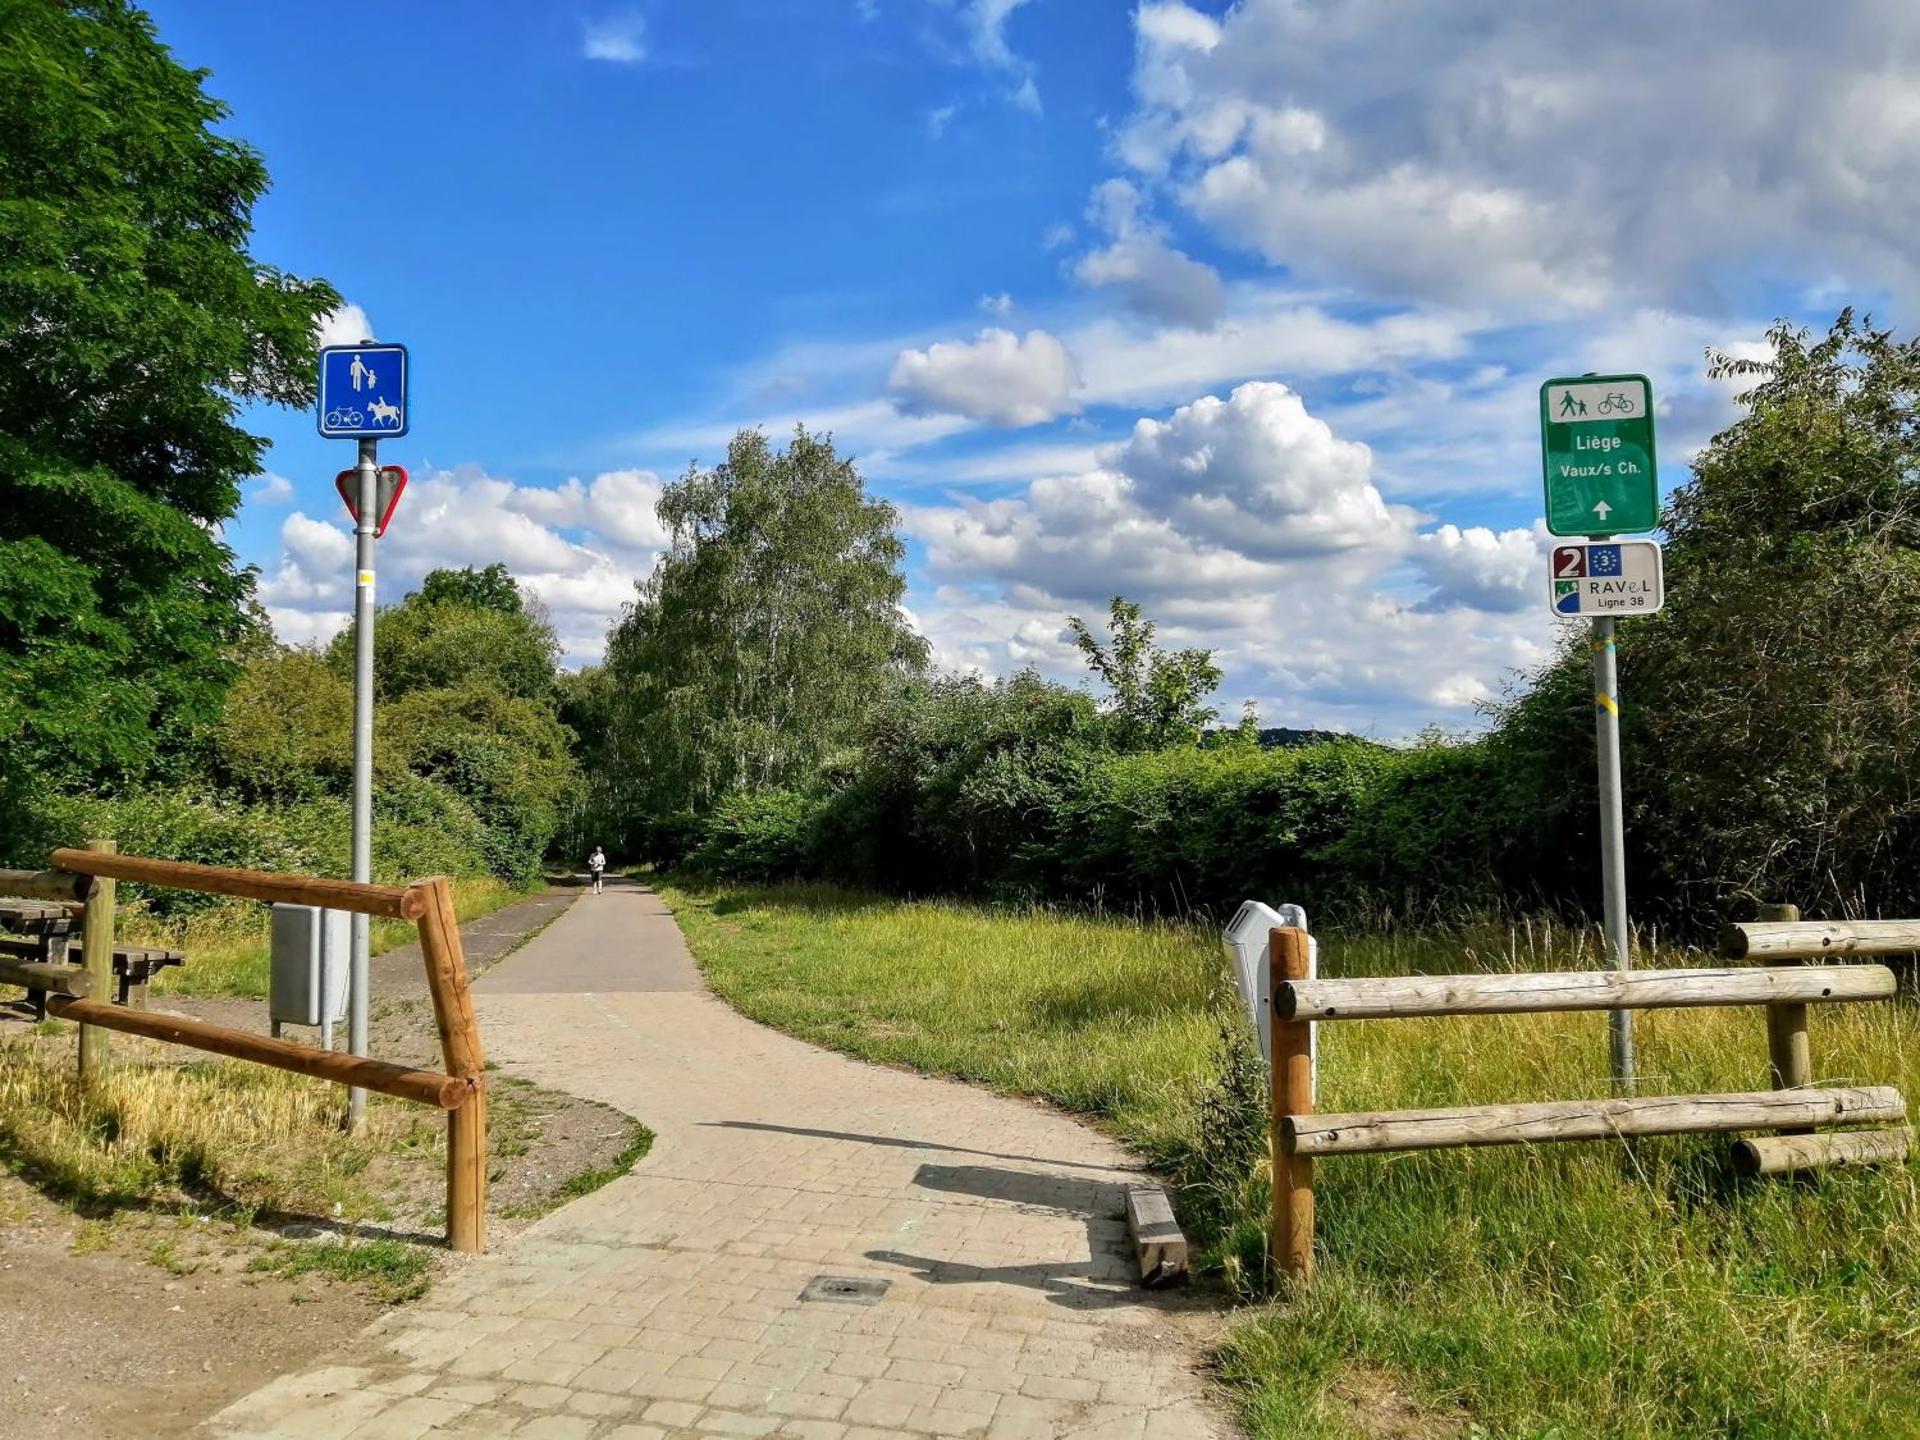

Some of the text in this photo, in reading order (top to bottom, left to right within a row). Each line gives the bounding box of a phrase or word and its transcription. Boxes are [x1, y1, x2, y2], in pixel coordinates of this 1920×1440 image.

[1576, 435, 1622, 451] Liège
[1561, 461, 1641, 478] Vaux/s Ch.
[1558, 548, 1582, 577] 2
[1601, 556, 1609, 566] 3
[1598, 597, 1644, 609] Ligne 38
